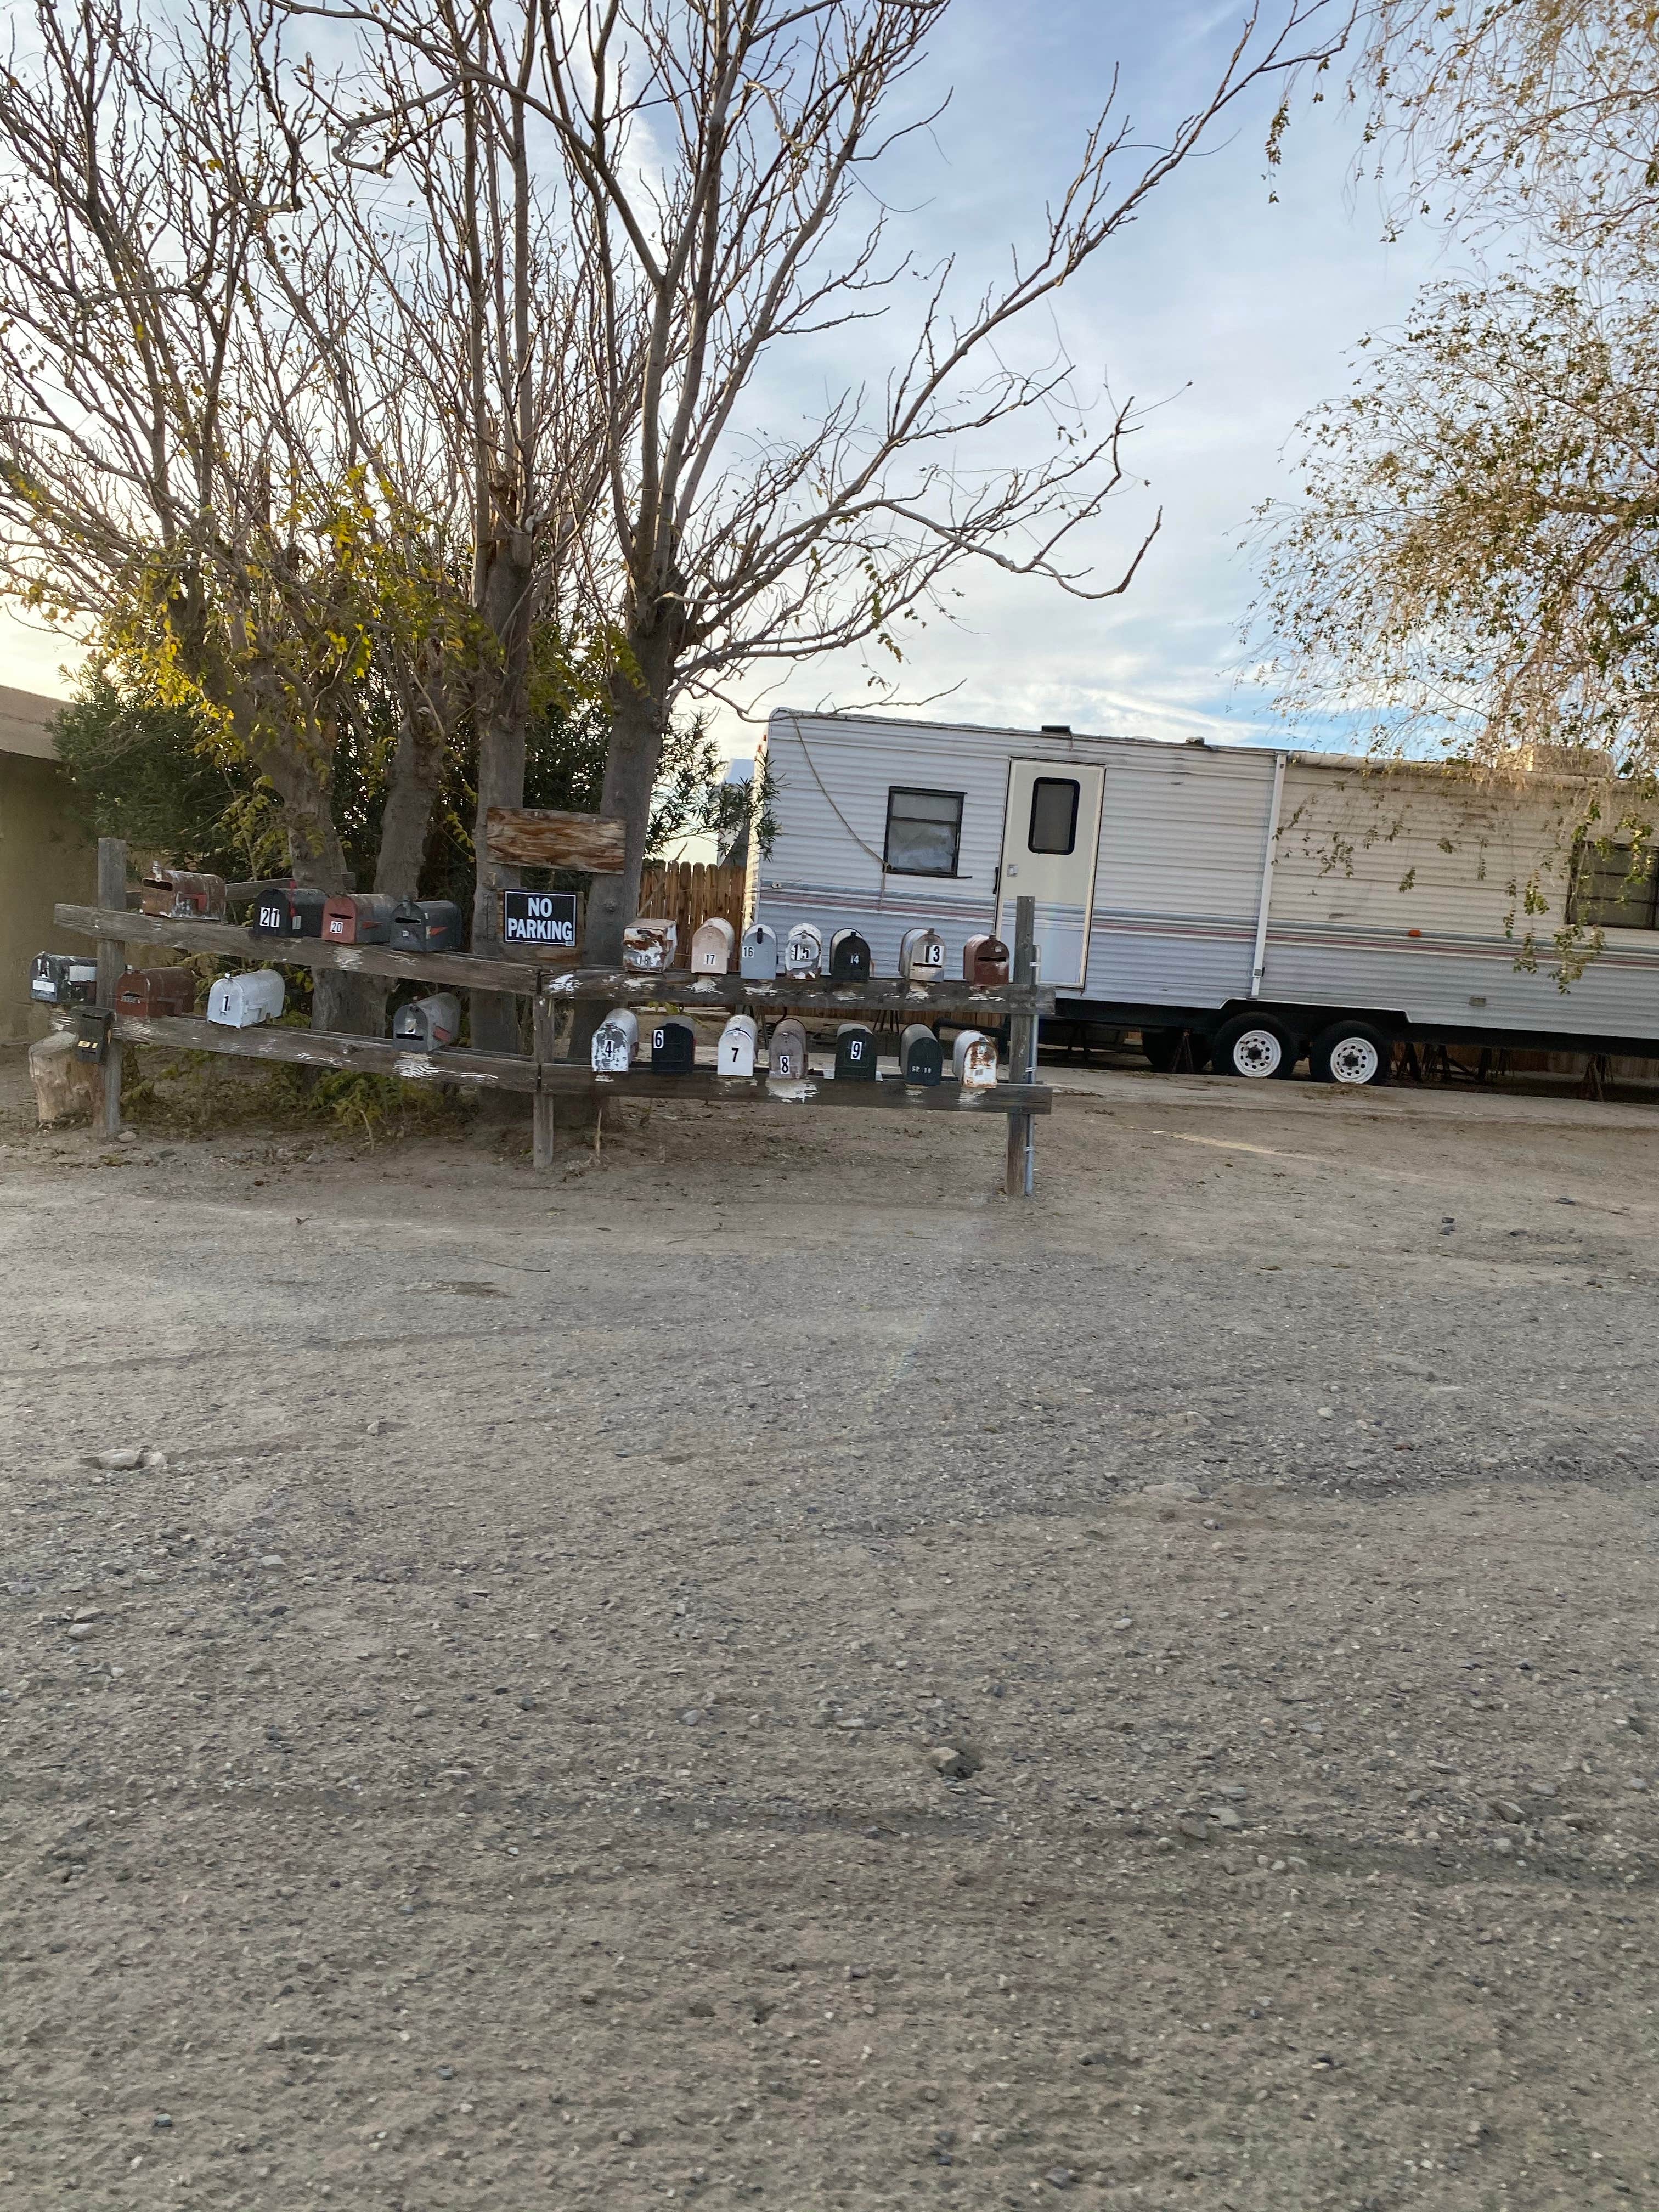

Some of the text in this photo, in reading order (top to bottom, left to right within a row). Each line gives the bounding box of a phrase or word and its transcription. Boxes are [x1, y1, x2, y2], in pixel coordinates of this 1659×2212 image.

[528, 897, 553, 917] NO
[262, 909, 278, 927] 21
[331, 922, 342, 933] 20
[507, 918, 573, 941] PARKING
[706, 954, 715, 964] 17
[744, 947, 754, 957] 16
[850, 955, 860, 964] 14
[926, 946, 940, 963] 13
[224, 996, 229, 1011] 1
[655, 1031, 662, 1047] 6
[605, 1041, 612, 1057] 4
[731, 1047, 740, 1063] 7
[852, 1042, 860, 1059] 9
[781, 1057, 788, 1073] 8
